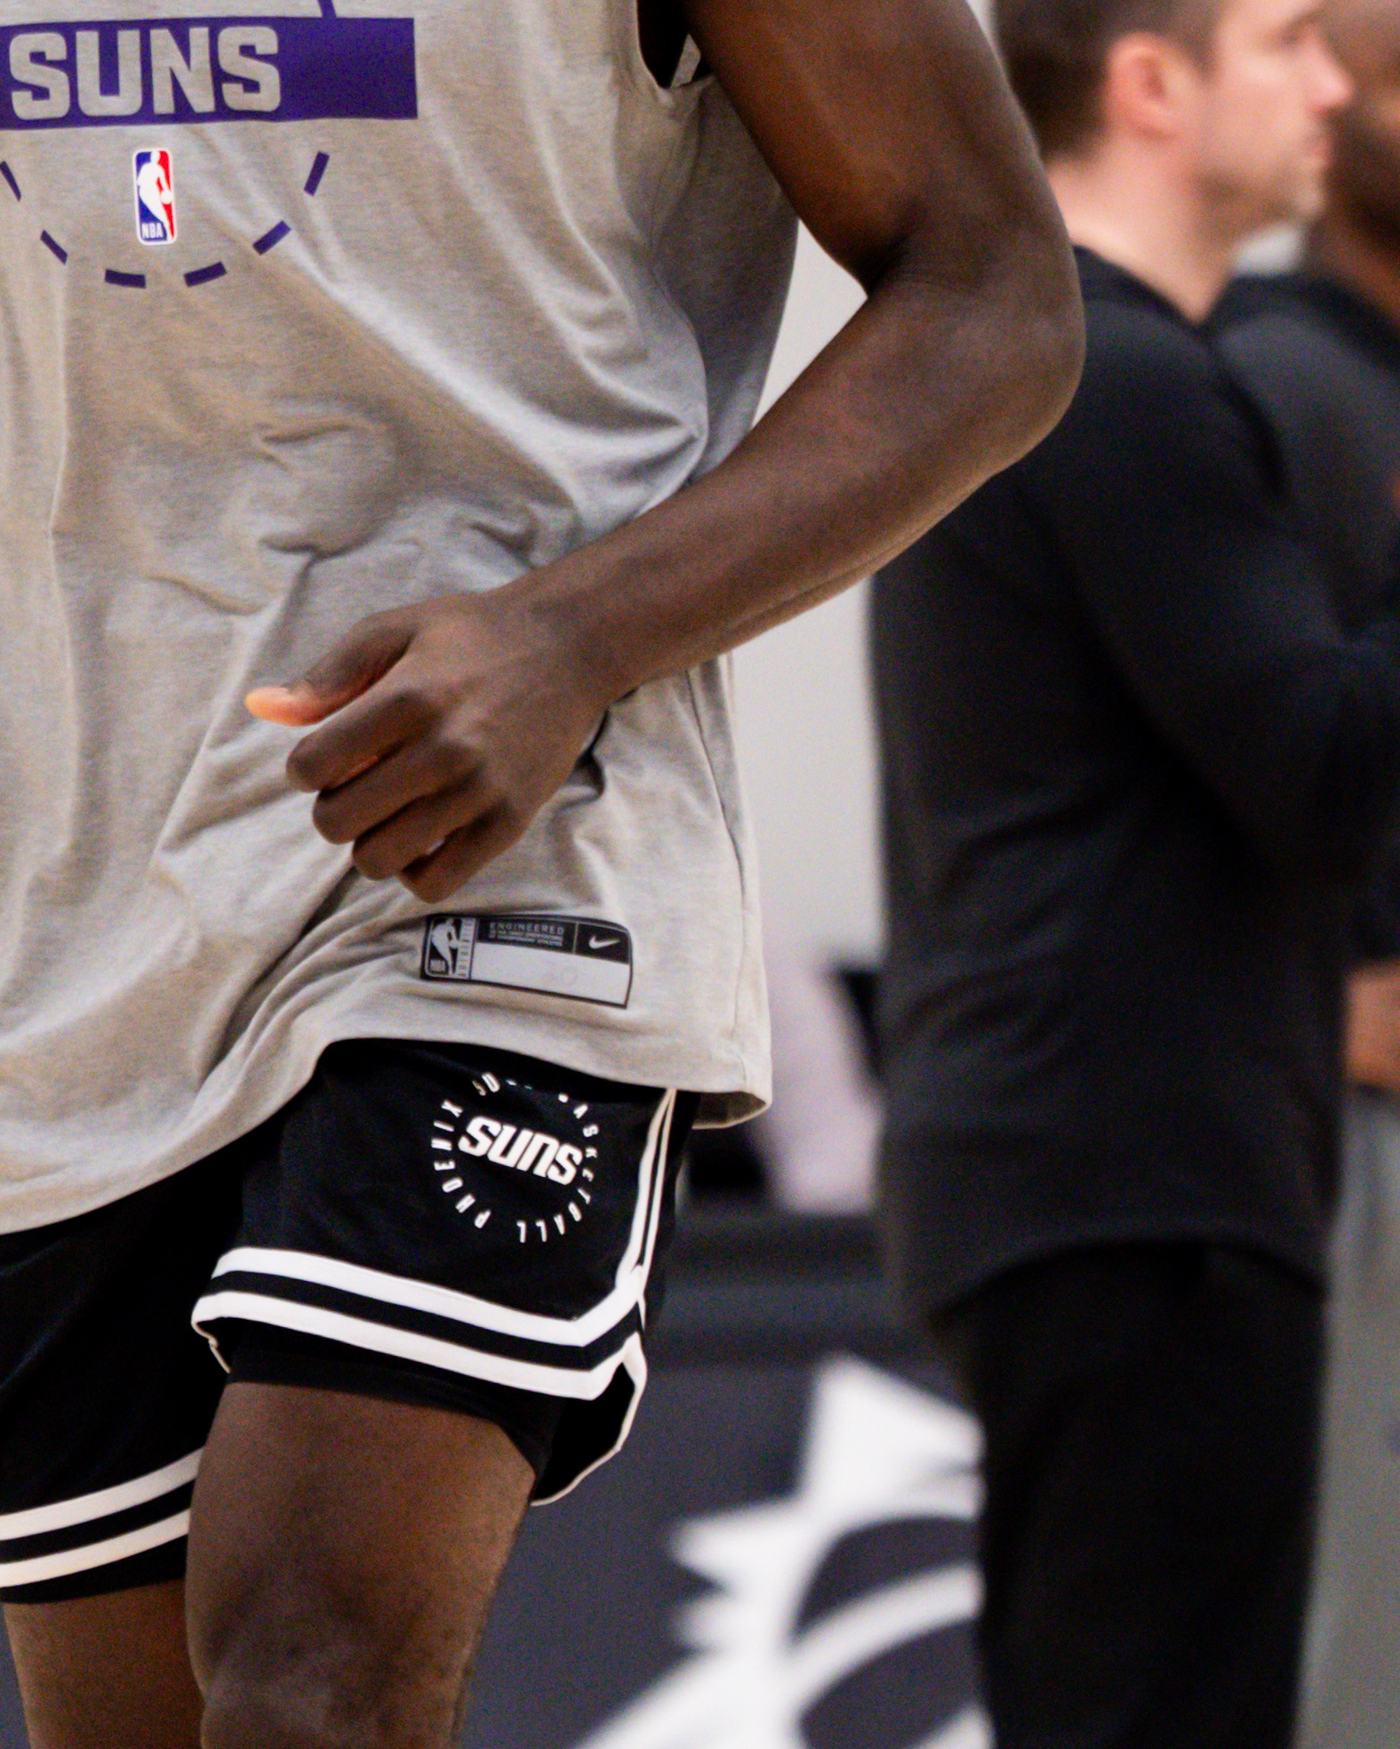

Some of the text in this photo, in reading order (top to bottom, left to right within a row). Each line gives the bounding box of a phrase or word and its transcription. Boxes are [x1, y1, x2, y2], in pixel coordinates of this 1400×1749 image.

[8, 24, 283, 121] SUNS
[141, 222, 164, 239] NBA
[489, 921, 564, 935] ENGINEERED
[457, 1114, 583, 1186] SUNS
